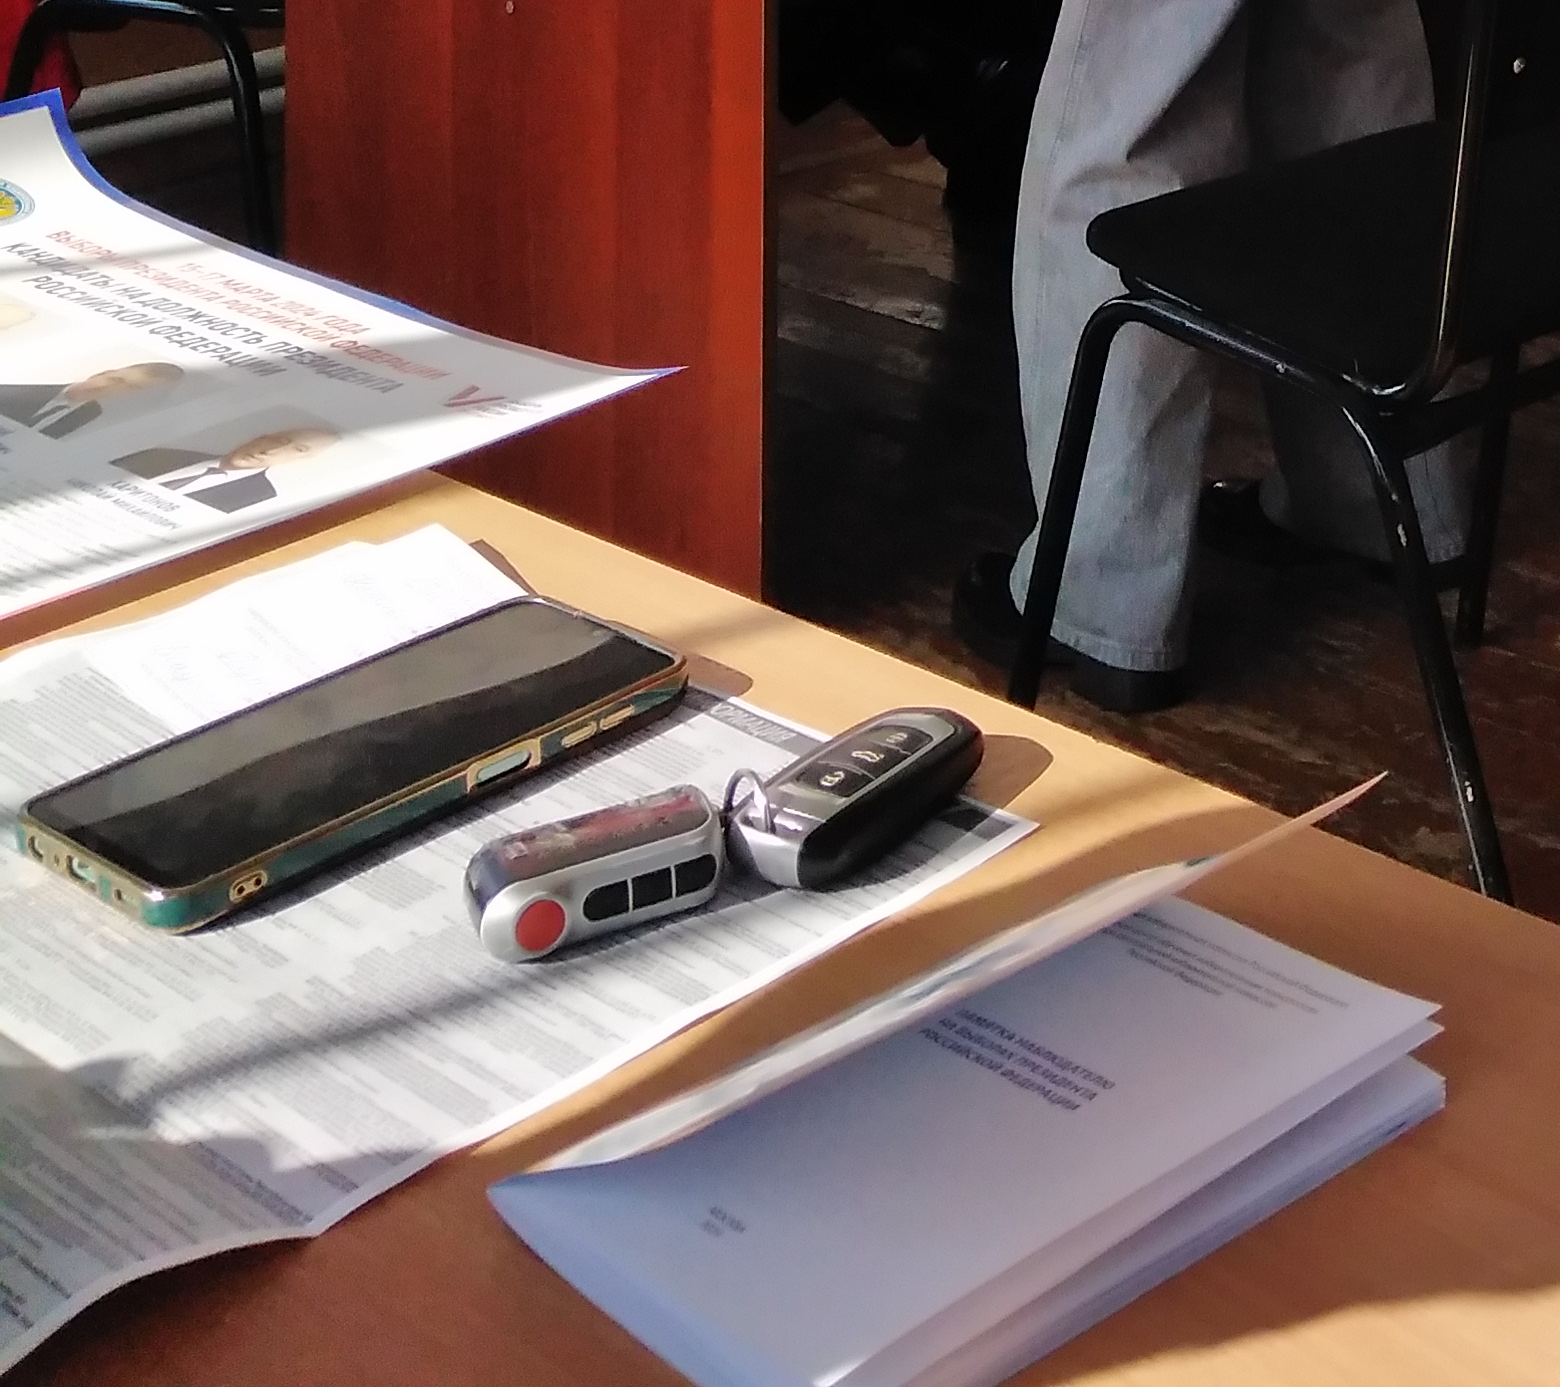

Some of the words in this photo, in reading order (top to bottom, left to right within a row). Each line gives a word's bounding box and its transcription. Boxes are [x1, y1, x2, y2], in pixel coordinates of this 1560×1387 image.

[1, 241, 122, 293] КАНДИДАТЫ
[114, 284, 142, 306] НА
[135, 295, 268, 345] ДОЛЖНОСТЬ
[260, 340, 405, 394] ПРЕЗИДЕНТА
[21, 275, 160, 328] РОССИЙСКОЙ
[147, 324, 287, 377] ФЕДЕРАЦИИ
[45, 230, 120, 263] ВЫБОРЫ
[116, 257, 226, 304] ПРЕЗИДЕНТА
[219, 297, 340, 346] РОССИЙСКОЙ
[329, 339, 453, 381] ФЕДЕРАЦИИ
[219, 279, 281, 304] МАРТА
[271, 300, 321, 319] 2024
[316, 314, 372, 336] ГОДА
[110, 480, 181, 513] ХАРИТОНОВ
[919, 1027, 1004, 1073] РОССИЙСКОЙ
[999, 1068, 1082, 1111] ФЕДЕРАЦИИ
[1011, 1055, 1099, 1102] ПРЕЗИДЕНТА
